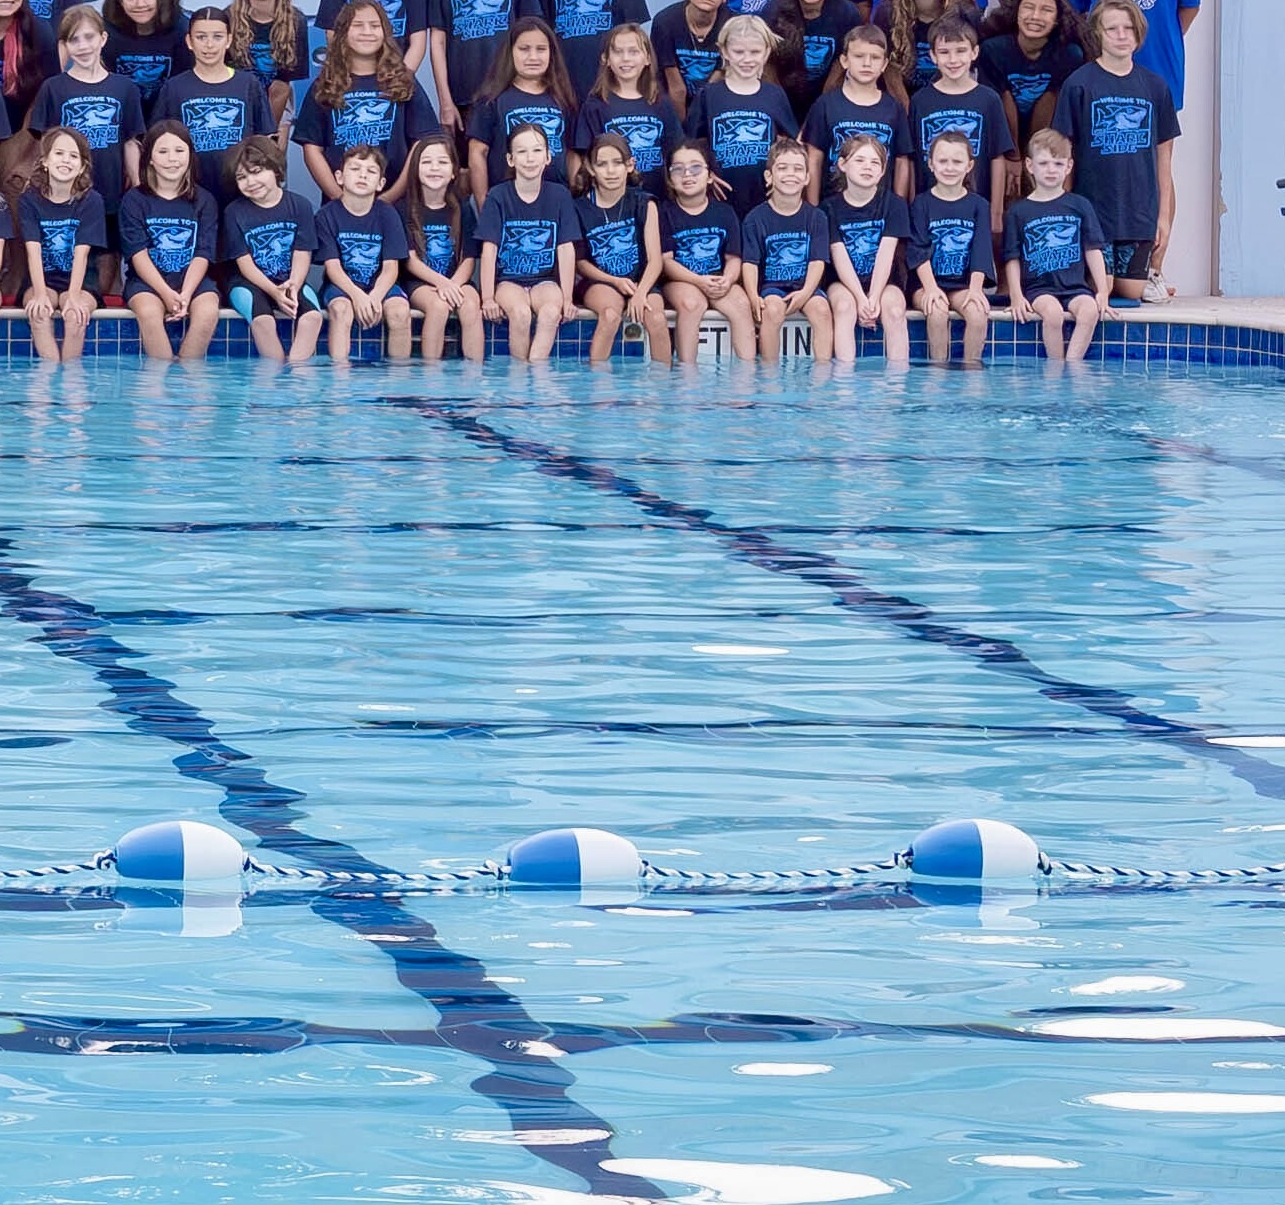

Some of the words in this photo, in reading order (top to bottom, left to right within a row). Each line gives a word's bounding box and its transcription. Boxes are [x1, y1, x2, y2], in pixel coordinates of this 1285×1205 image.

[190, 97, 227, 105] WELCOME
[1100, 97, 1136, 105] WELCOME
[515, 107, 548, 115] WELCOME
[721, 111, 758, 119] WELCOME
[930, 110, 965, 118] WELCOME
[839, 121, 877, 129] WELCOME
[1093, 130, 1149, 148] SHARK
[1100, 145, 1137, 154] SIDE
[723, 157, 758, 169] SIDE
[147, 218, 180, 226] WELCOME
[181, 218, 191, 226] TO
[506, 220, 541, 228] WELCOME
[1029, 216, 1063, 224] WELCOME
[251, 224, 284, 234] WELCOME
[591, 222, 627, 234] WELCOME
[782, 326, 812, 356] IN
